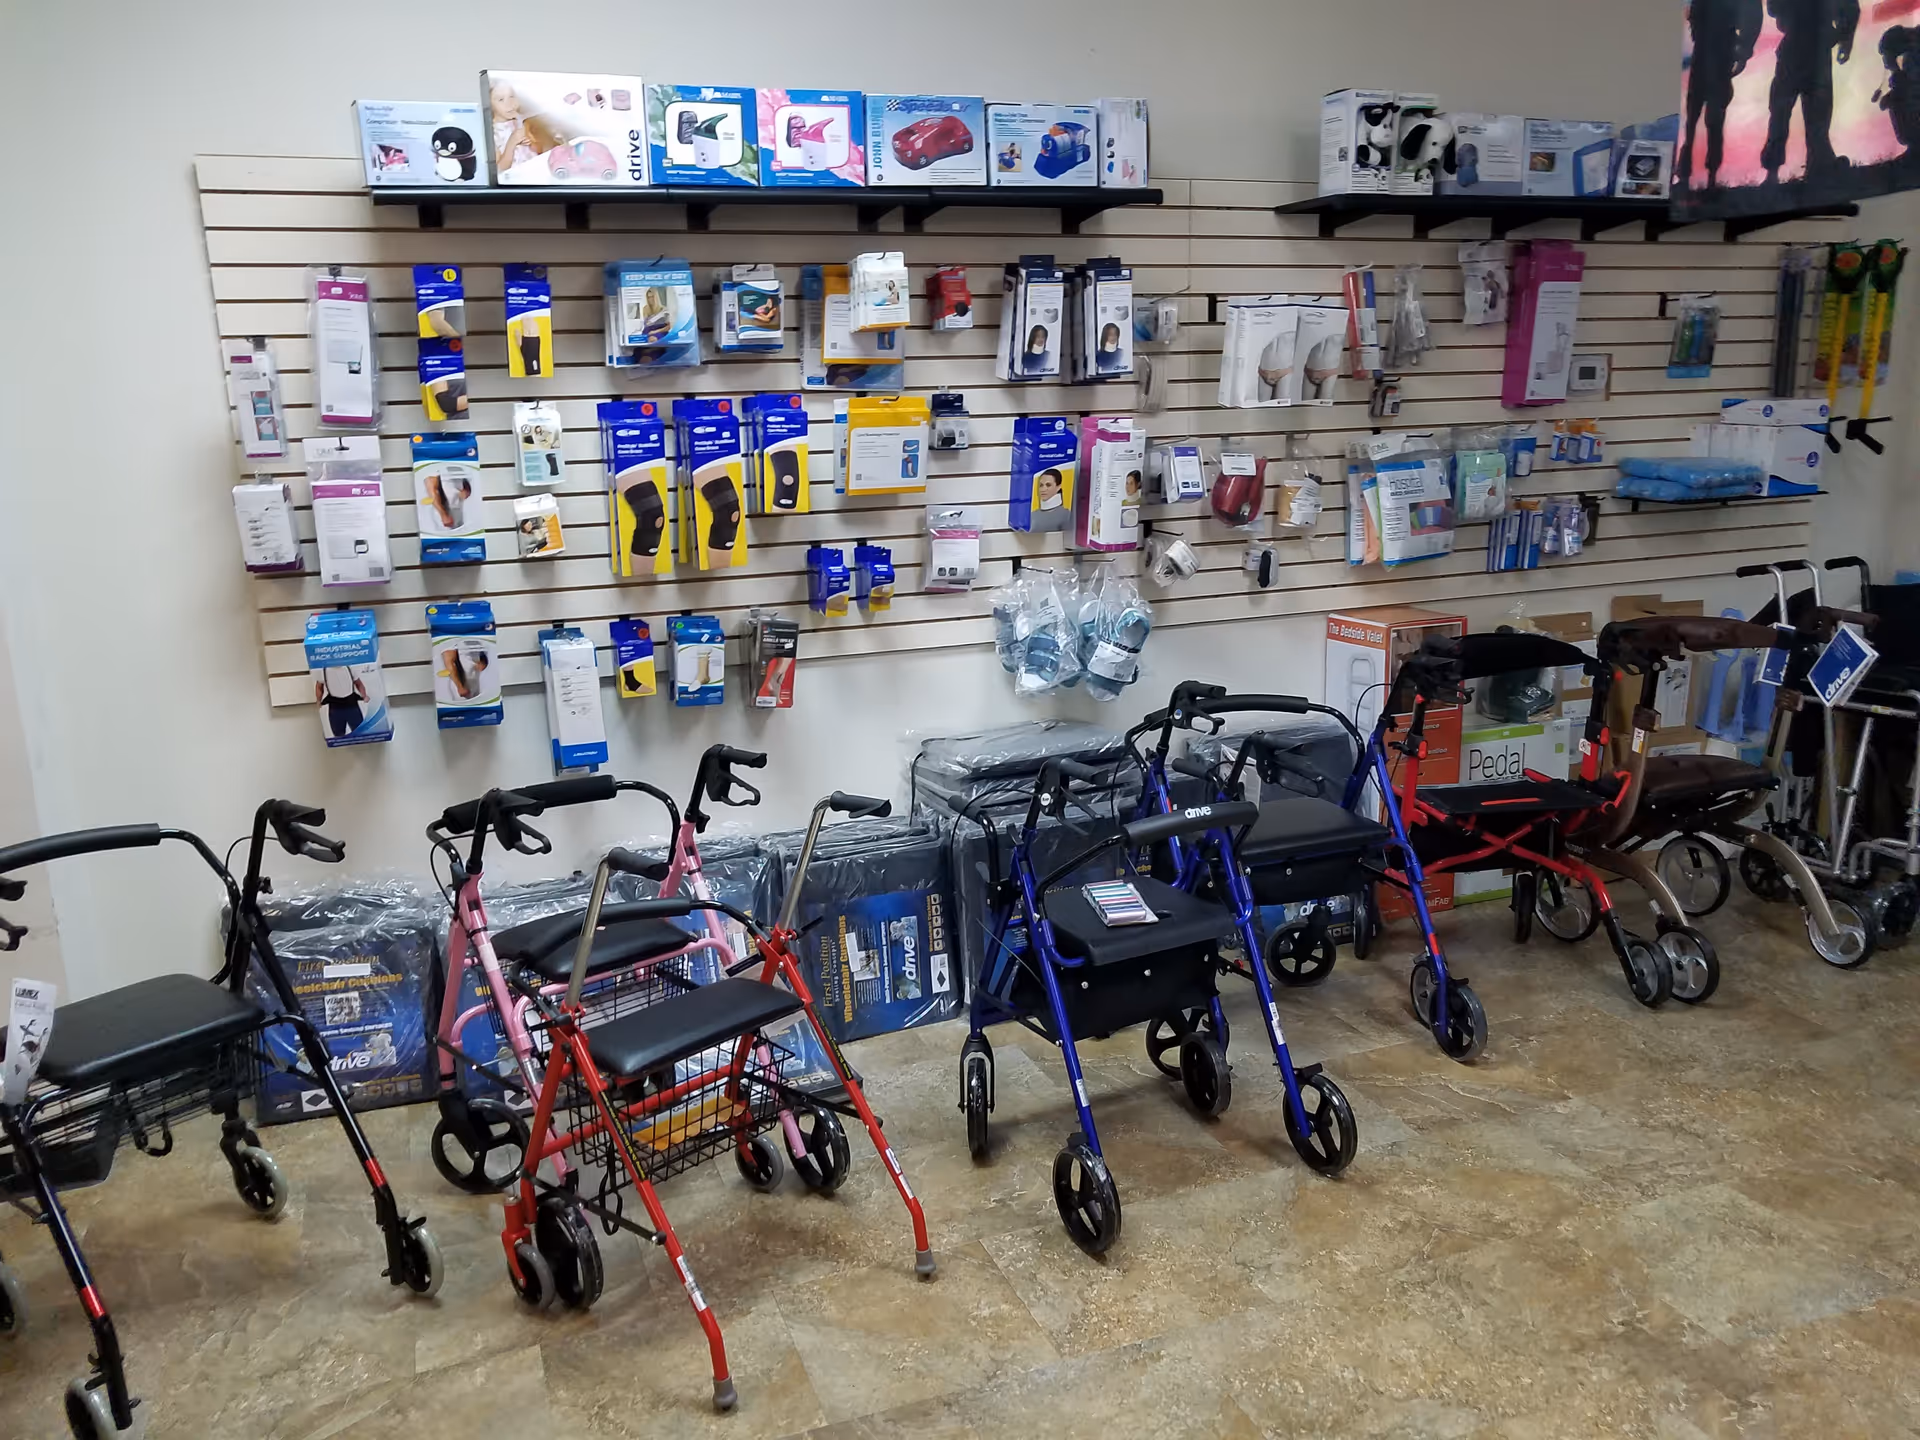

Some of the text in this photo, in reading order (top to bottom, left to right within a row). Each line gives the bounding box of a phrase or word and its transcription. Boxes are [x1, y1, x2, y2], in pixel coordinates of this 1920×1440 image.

[628, 129, 642, 181] drive
[872, 142, 882, 169] JOHN
[314, 643, 362, 654] INDUSTRIAL
[1329, 622, 1383, 644] The Bedside Valet
[1825, 667, 1851, 700] drive
[1469, 742, 1526, 782] Pedal
[1184, 806, 1212, 819] drive
[820, 935, 834, 1007] First Position
[838, 914, 853, 1023] Wheelchair Cushions
[901, 935, 917, 981] drive
[348, 973, 403, 988] Cushions
